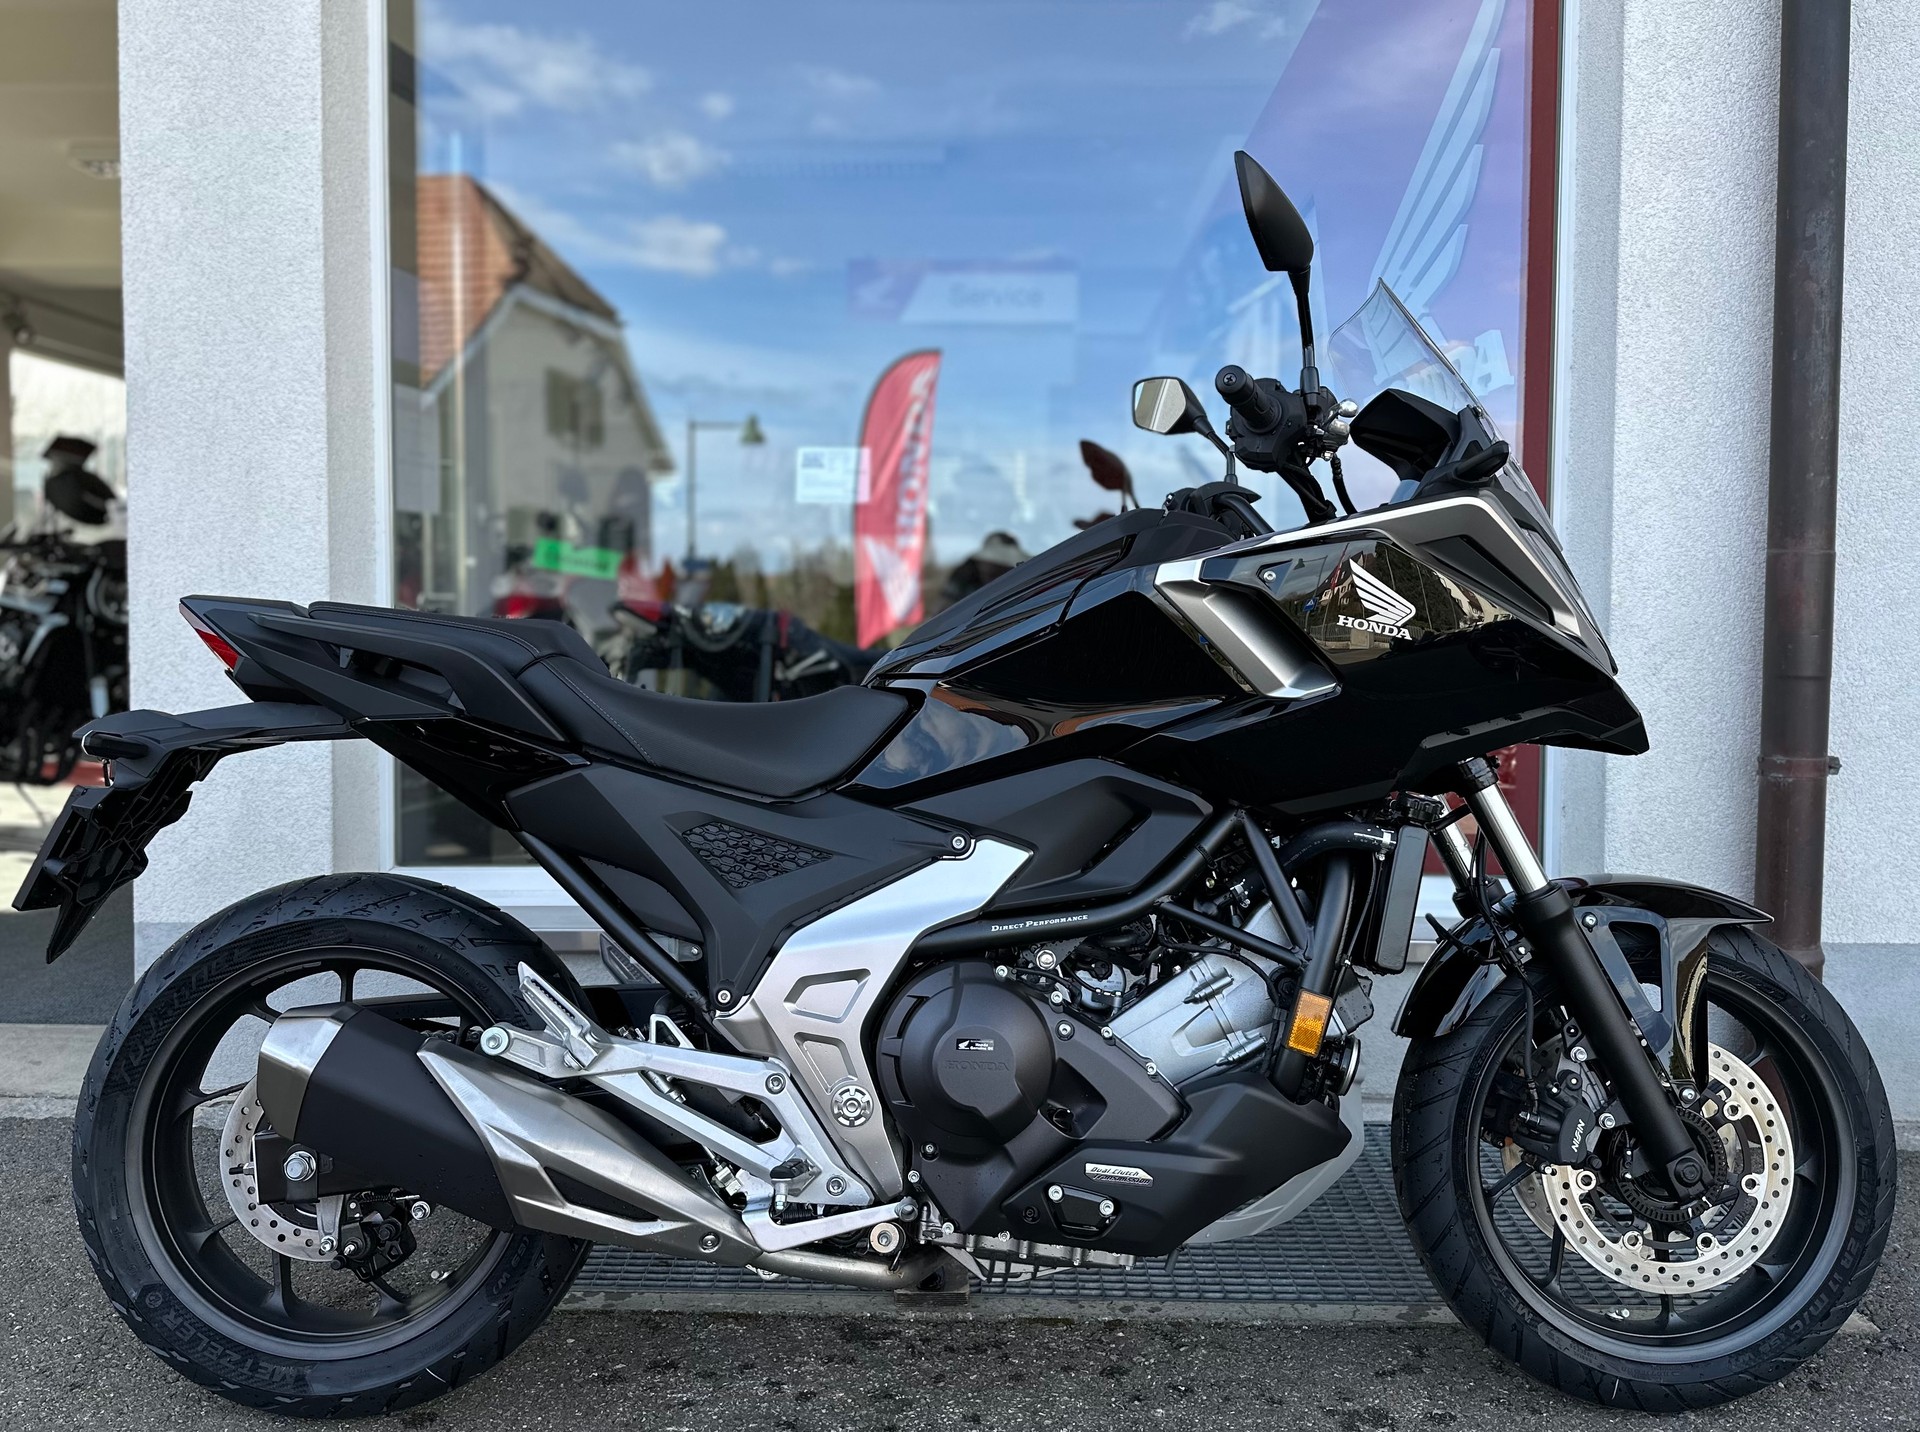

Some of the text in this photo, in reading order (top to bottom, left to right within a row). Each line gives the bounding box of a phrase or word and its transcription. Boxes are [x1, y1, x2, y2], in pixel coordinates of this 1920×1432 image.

[1336, 614, 1413, 641] HONDA
[1090, 1166, 1140, 1177] Dual Clutch
[158, 1305, 297, 1386] METZELER
